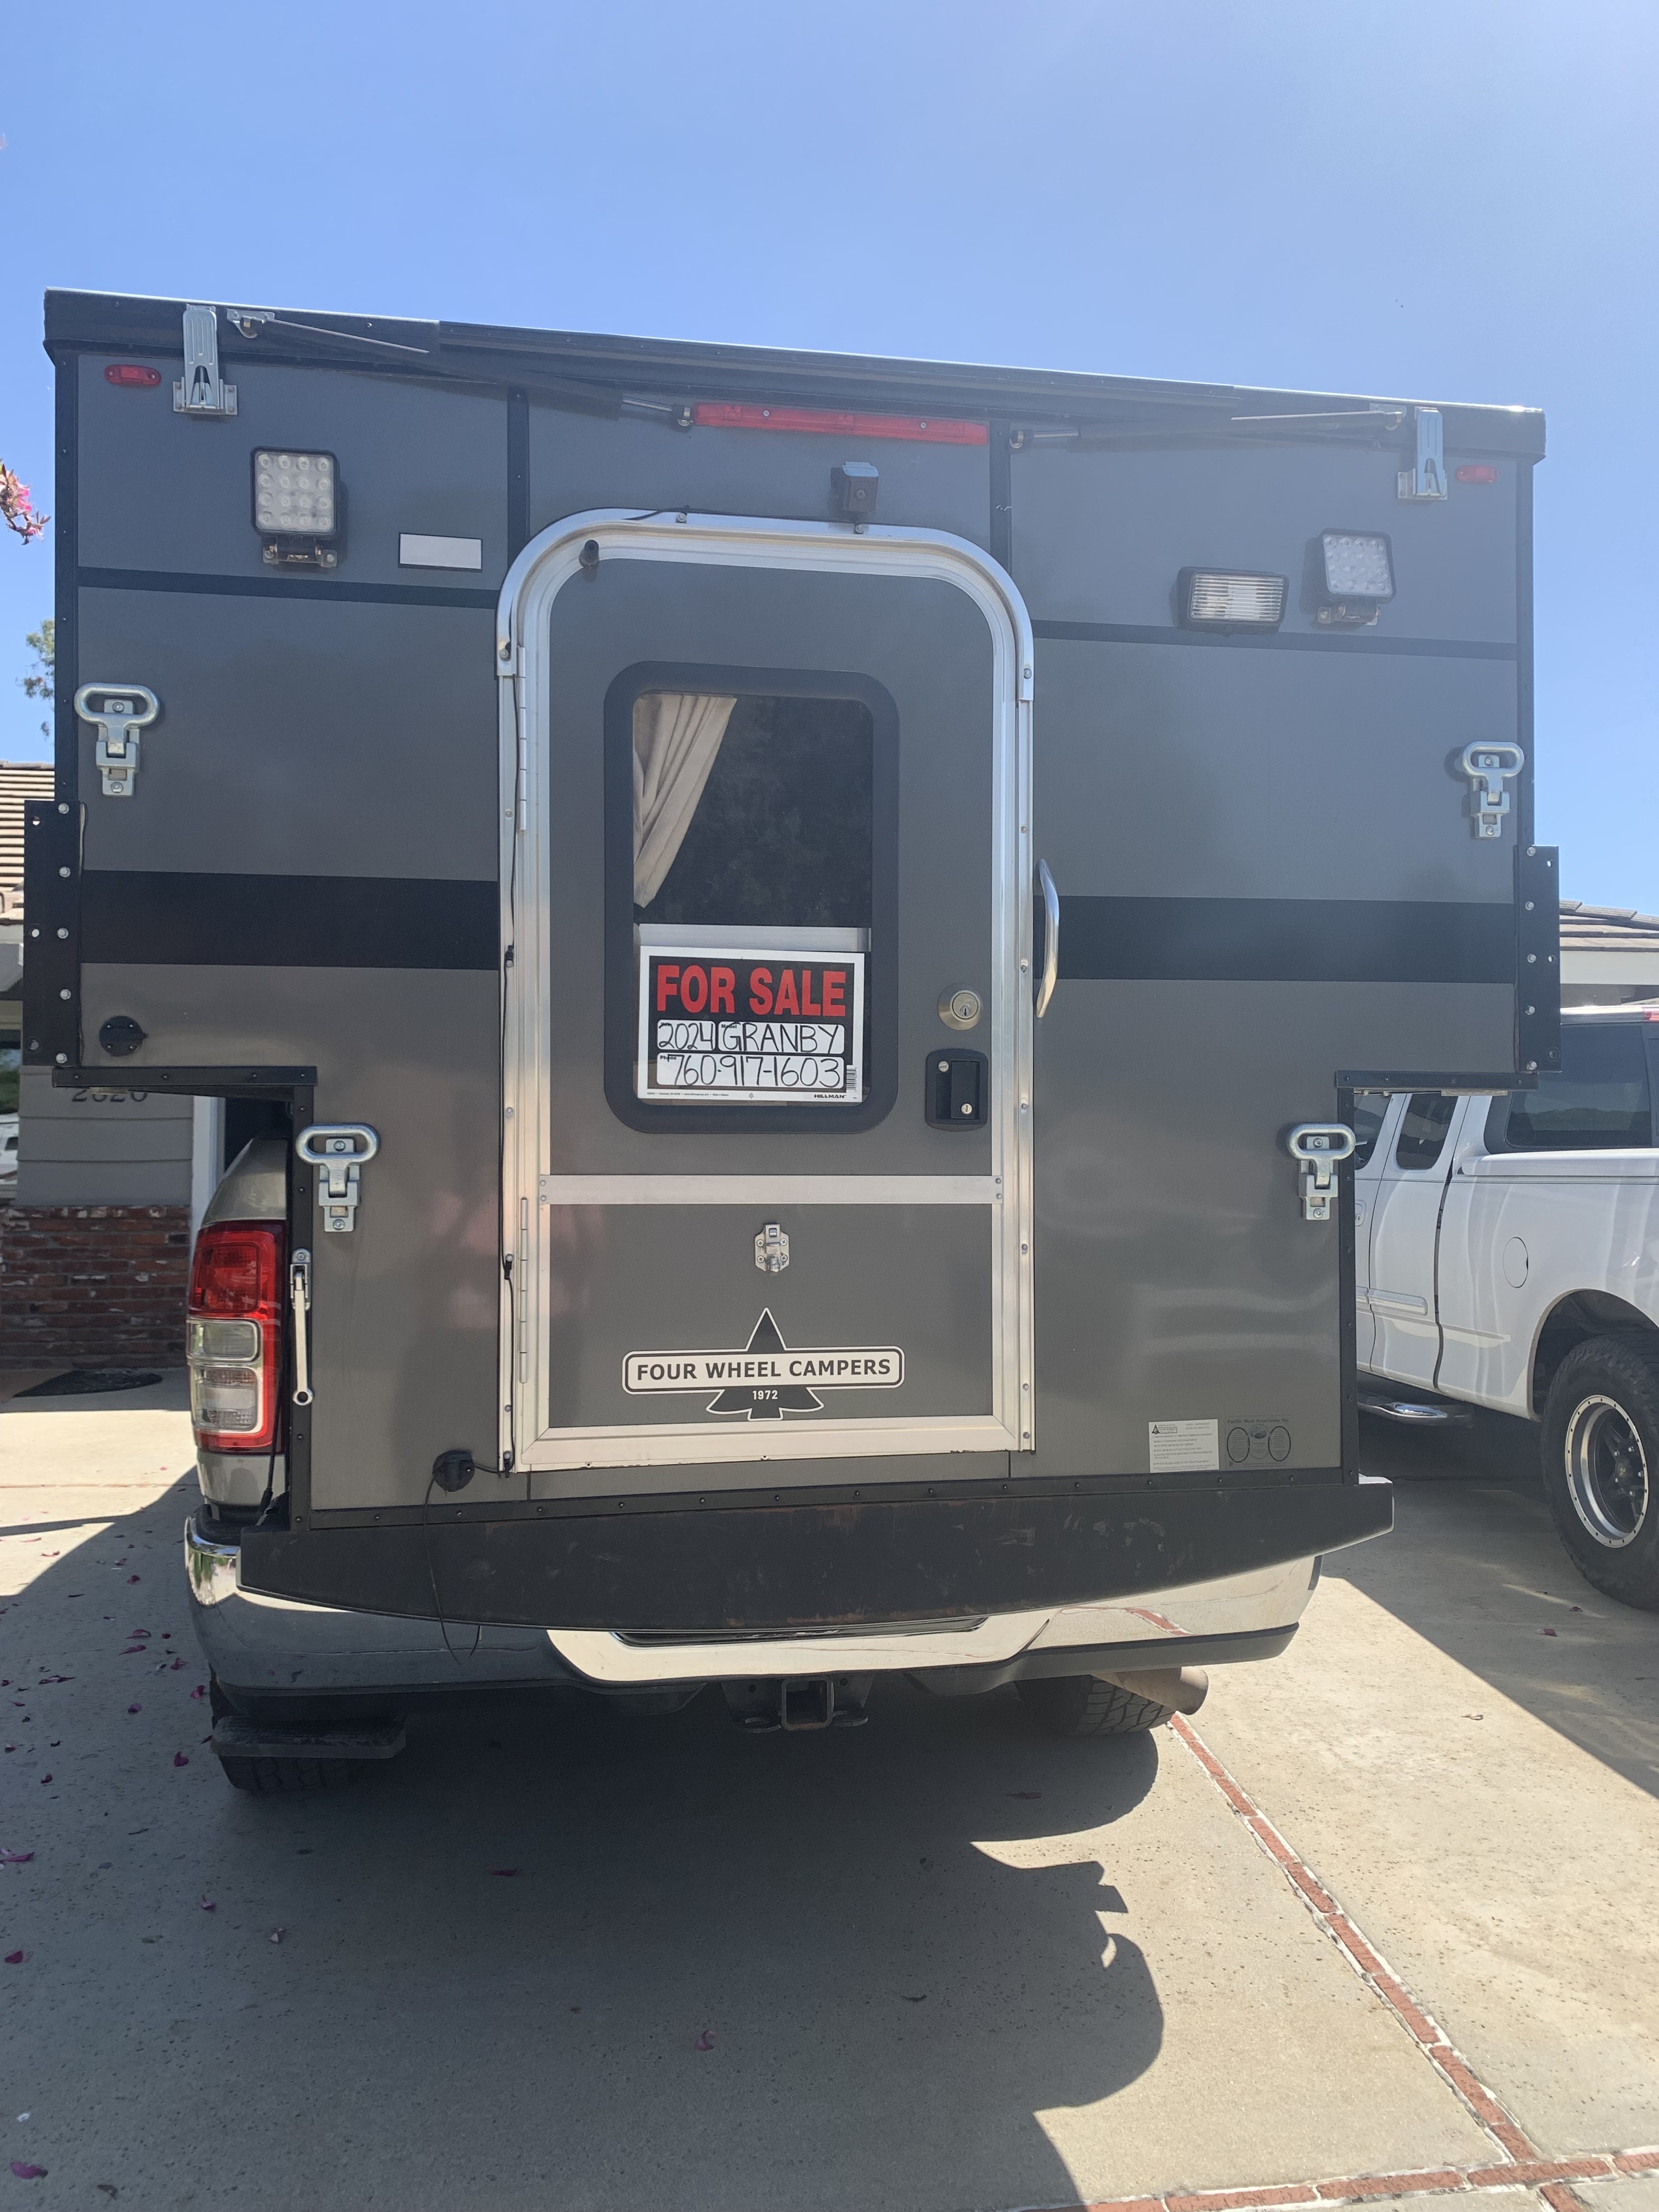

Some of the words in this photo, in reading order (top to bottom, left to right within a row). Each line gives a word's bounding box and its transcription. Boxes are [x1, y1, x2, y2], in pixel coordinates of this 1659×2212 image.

[657, 964, 736, 1013] FOR
[749, 967, 846, 1017] SALE
[658, 1022, 713, 1050] 2024
[723, 1021, 839, 1054] GRANBY
[637, 1363, 698, 1381] FOUR
[705, 1361, 782, 1379] WHEEL
[788, 1358, 891, 1377] CAMPERS
[752, 1390, 778, 1401] 1972
